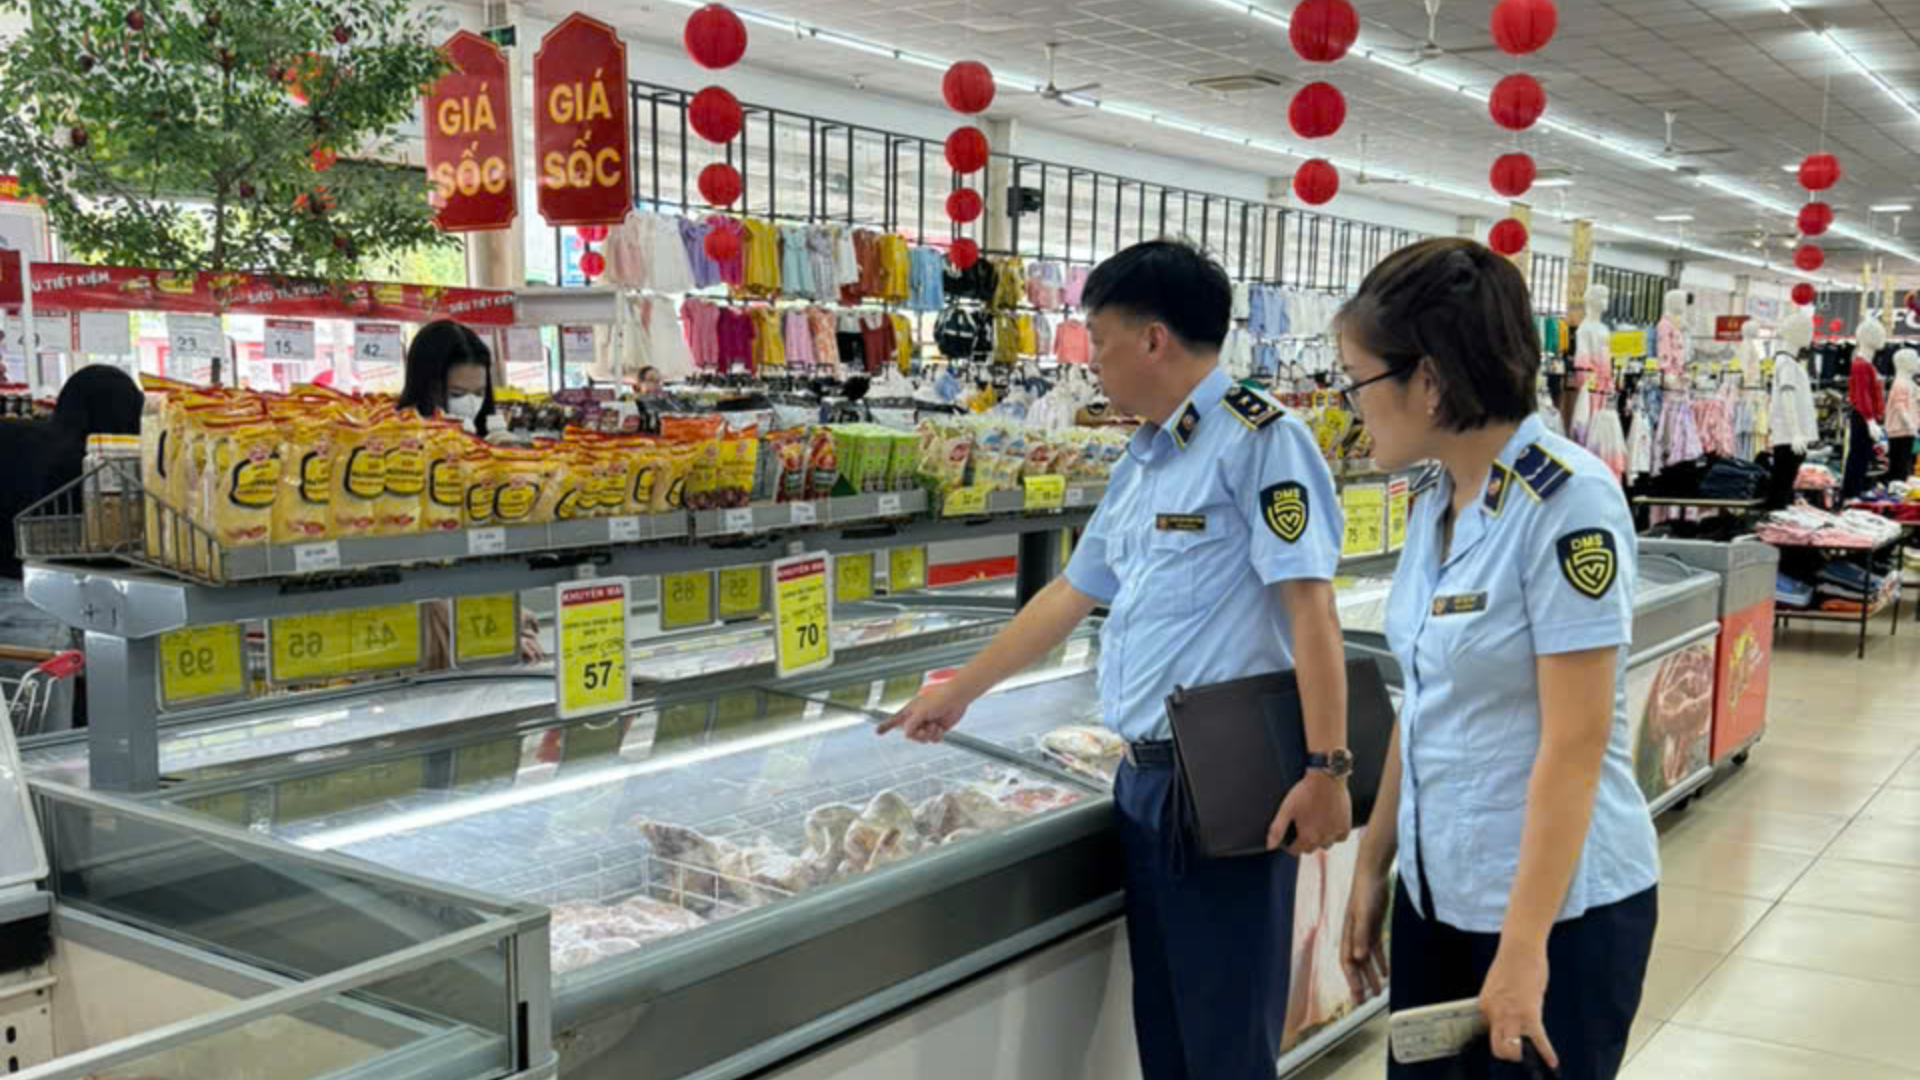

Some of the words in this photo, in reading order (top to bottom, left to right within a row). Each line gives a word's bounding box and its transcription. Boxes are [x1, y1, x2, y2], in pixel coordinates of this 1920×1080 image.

[437, 82, 497, 135] GIÁ
[548, 68, 612, 123] GIÁ
[435, 141, 506, 198] SỐC
[543, 130, 622, 190] SỐC
[176, 335, 198, 351] 23
[275, 339, 292, 354] 15
[362, 342, 381, 357] 42
[1273, 487, 1300, 500] DMS
[1571, 533, 1603, 550] DMS
[797, 622, 819, 649] 70
[583, 661, 613, 690] 57
